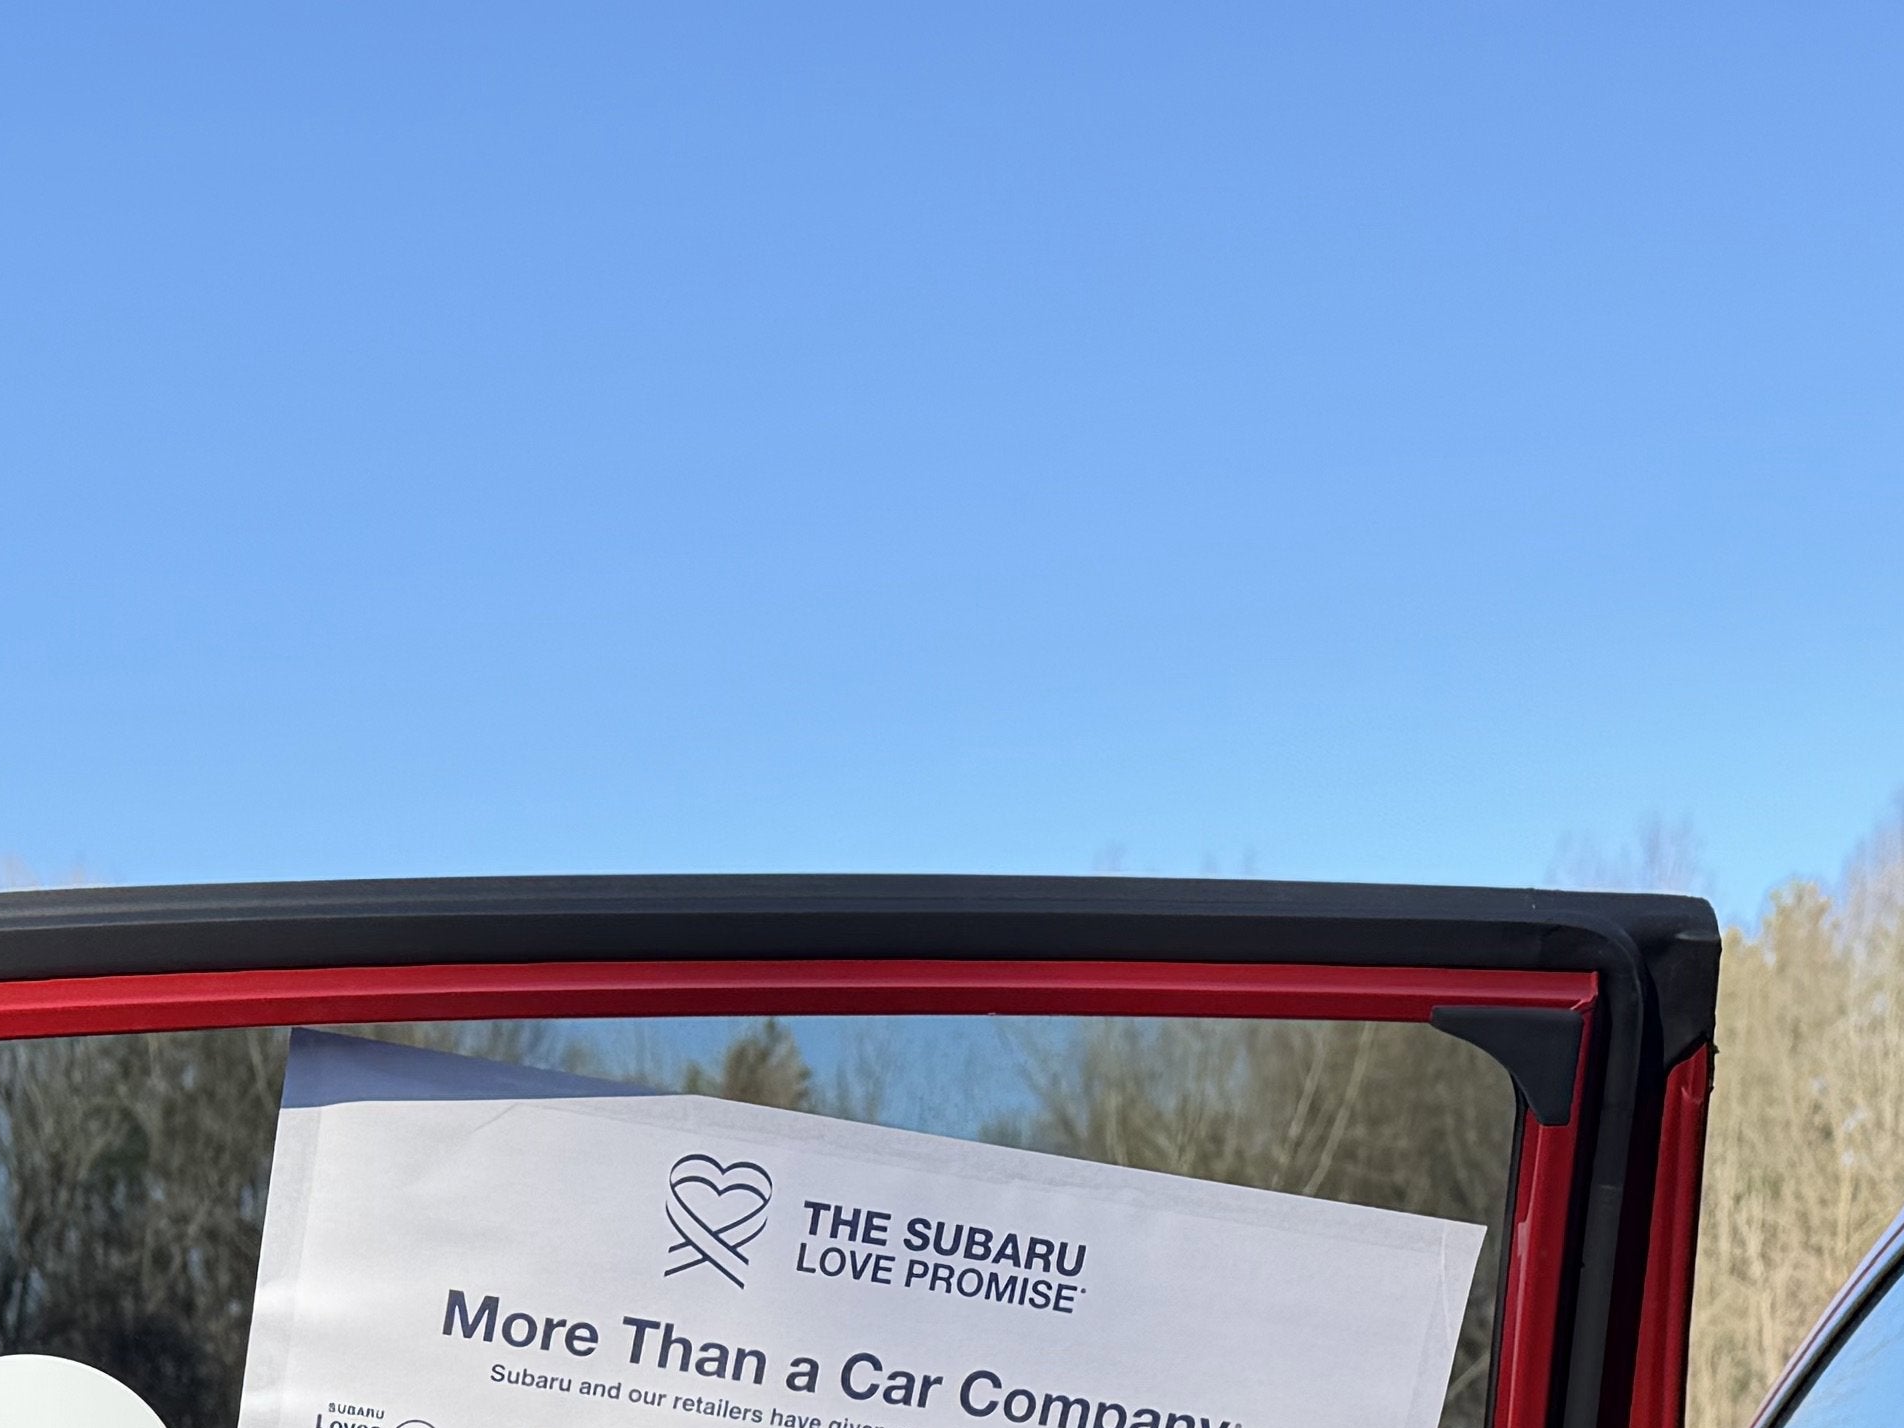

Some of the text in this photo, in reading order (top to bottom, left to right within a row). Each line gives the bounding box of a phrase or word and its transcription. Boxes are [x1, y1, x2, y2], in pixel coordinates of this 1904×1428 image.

[797, 1243, 895, 1284] LOVE
[804, 1200, 1086, 1277] THE SUBARU
[441, 1289, 598, 1357] More
[621, 1316, 767, 1384] Than
[786, 1356, 820, 1393] a
[841, 1352, 943, 1408] Car
[328, 1402, 385, 1420] SUBARU
[490, 1364, 572, 1392] Subaru
[579, 1377, 621, 1400] and
[628, 1388, 666, 1407] our
[672, 1395, 763, 1424] retailers
